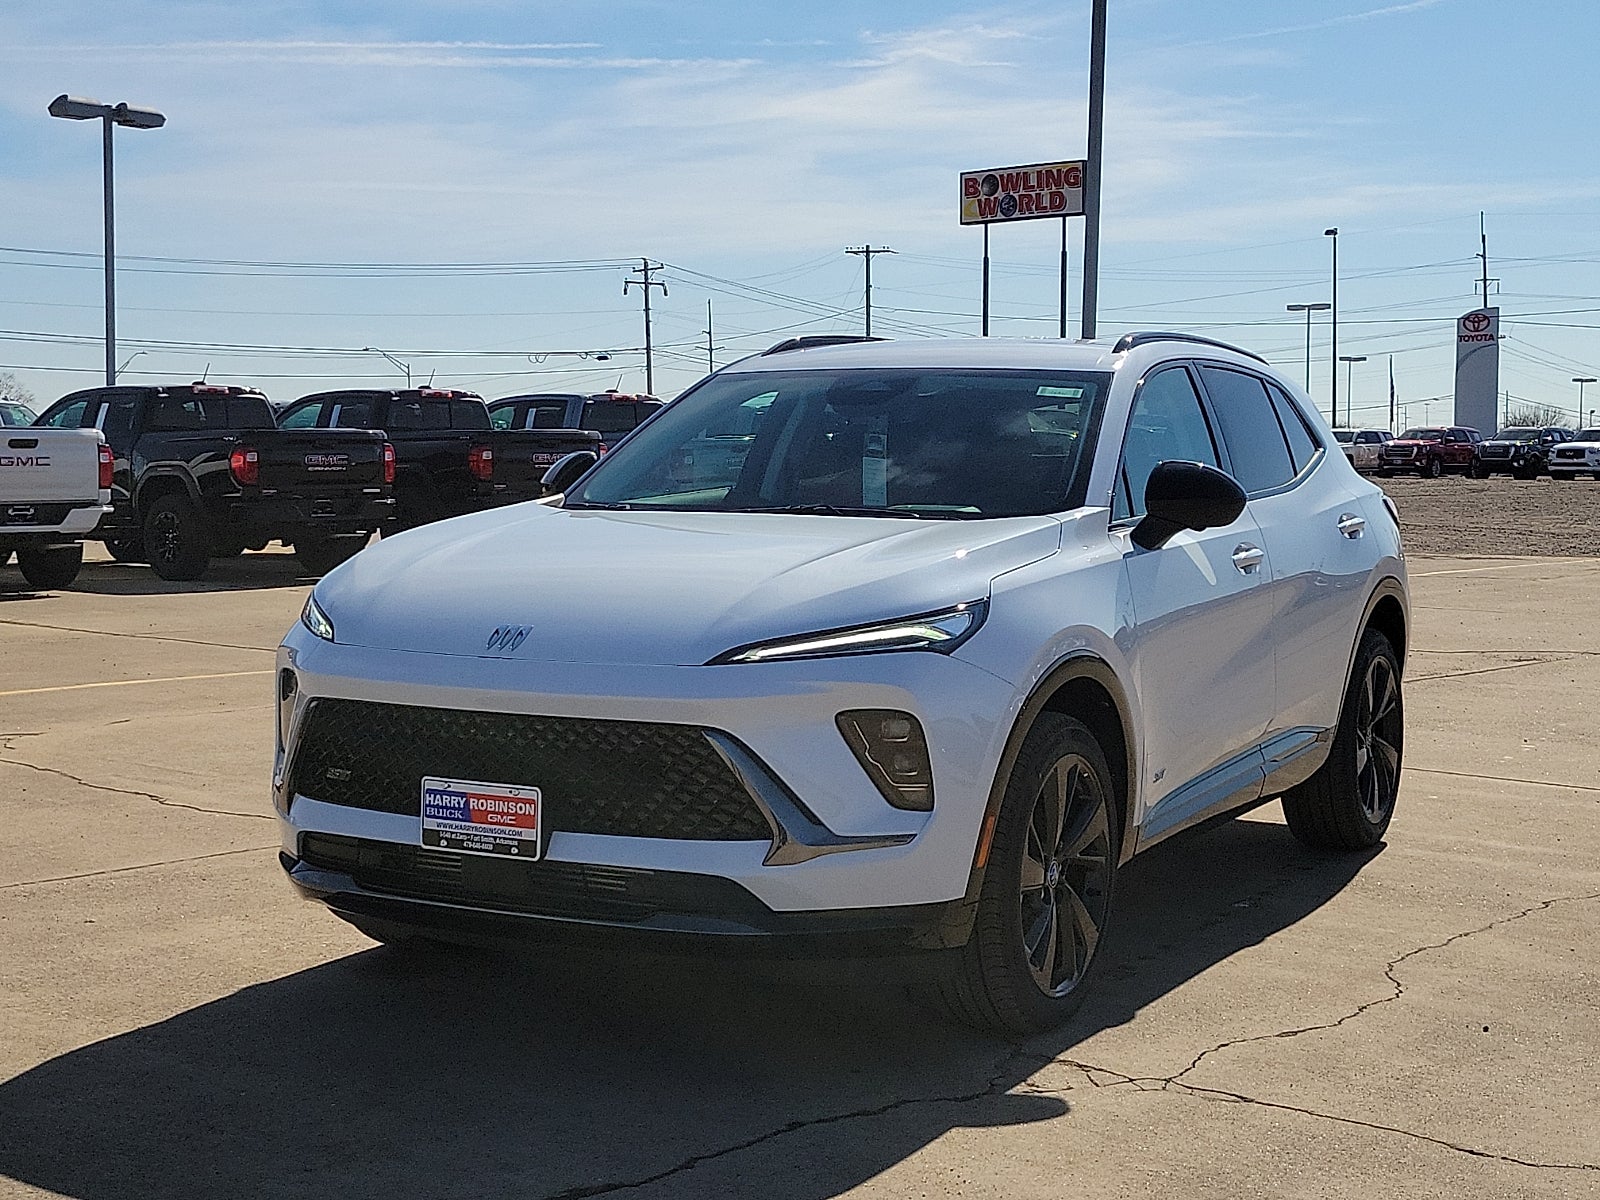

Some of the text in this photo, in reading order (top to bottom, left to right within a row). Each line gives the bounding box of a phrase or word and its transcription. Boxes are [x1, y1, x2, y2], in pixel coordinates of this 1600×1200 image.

[964, 166, 1081, 199] BOWLING
[977, 191, 1067, 219] WORLD
[1457, 333, 1495, 343] TOYOTA
[0, 456, 51, 467] GMC
[304, 454, 349, 465] GMC
[425, 793, 535, 815] HARRY ROBINSON
[426, 807, 464, 819] BUICK
[487, 814, 517, 824] GMC
[436, 822, 523, 837] WWW.HARRYROBINSON.COM
